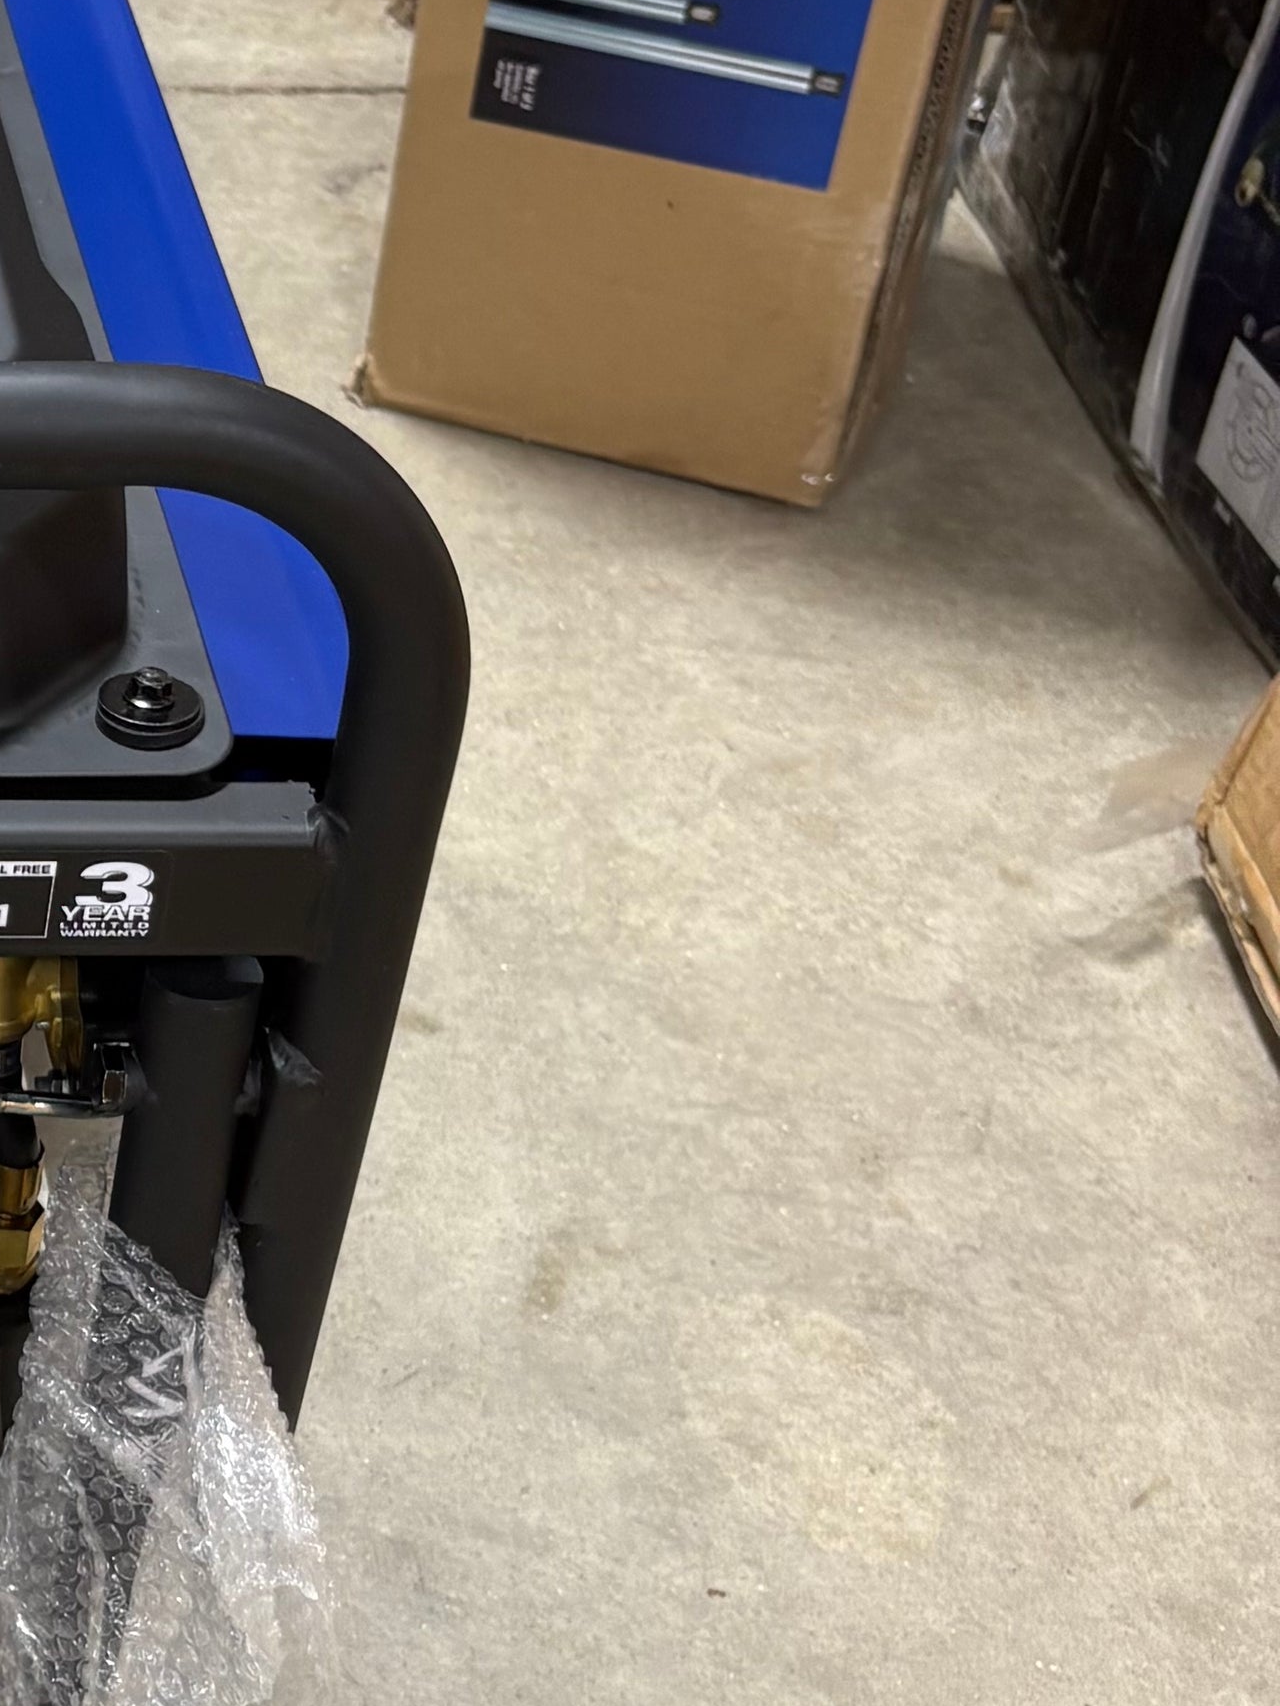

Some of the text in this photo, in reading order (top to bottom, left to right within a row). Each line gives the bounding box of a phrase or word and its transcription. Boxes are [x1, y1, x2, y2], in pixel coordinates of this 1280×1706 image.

[13, 864, 50, 873] FREE
[75, 861, 155, 906] 3
[61, 905, 151, 922] YEAR
[60, 929, 149, 937] WARRANTY
